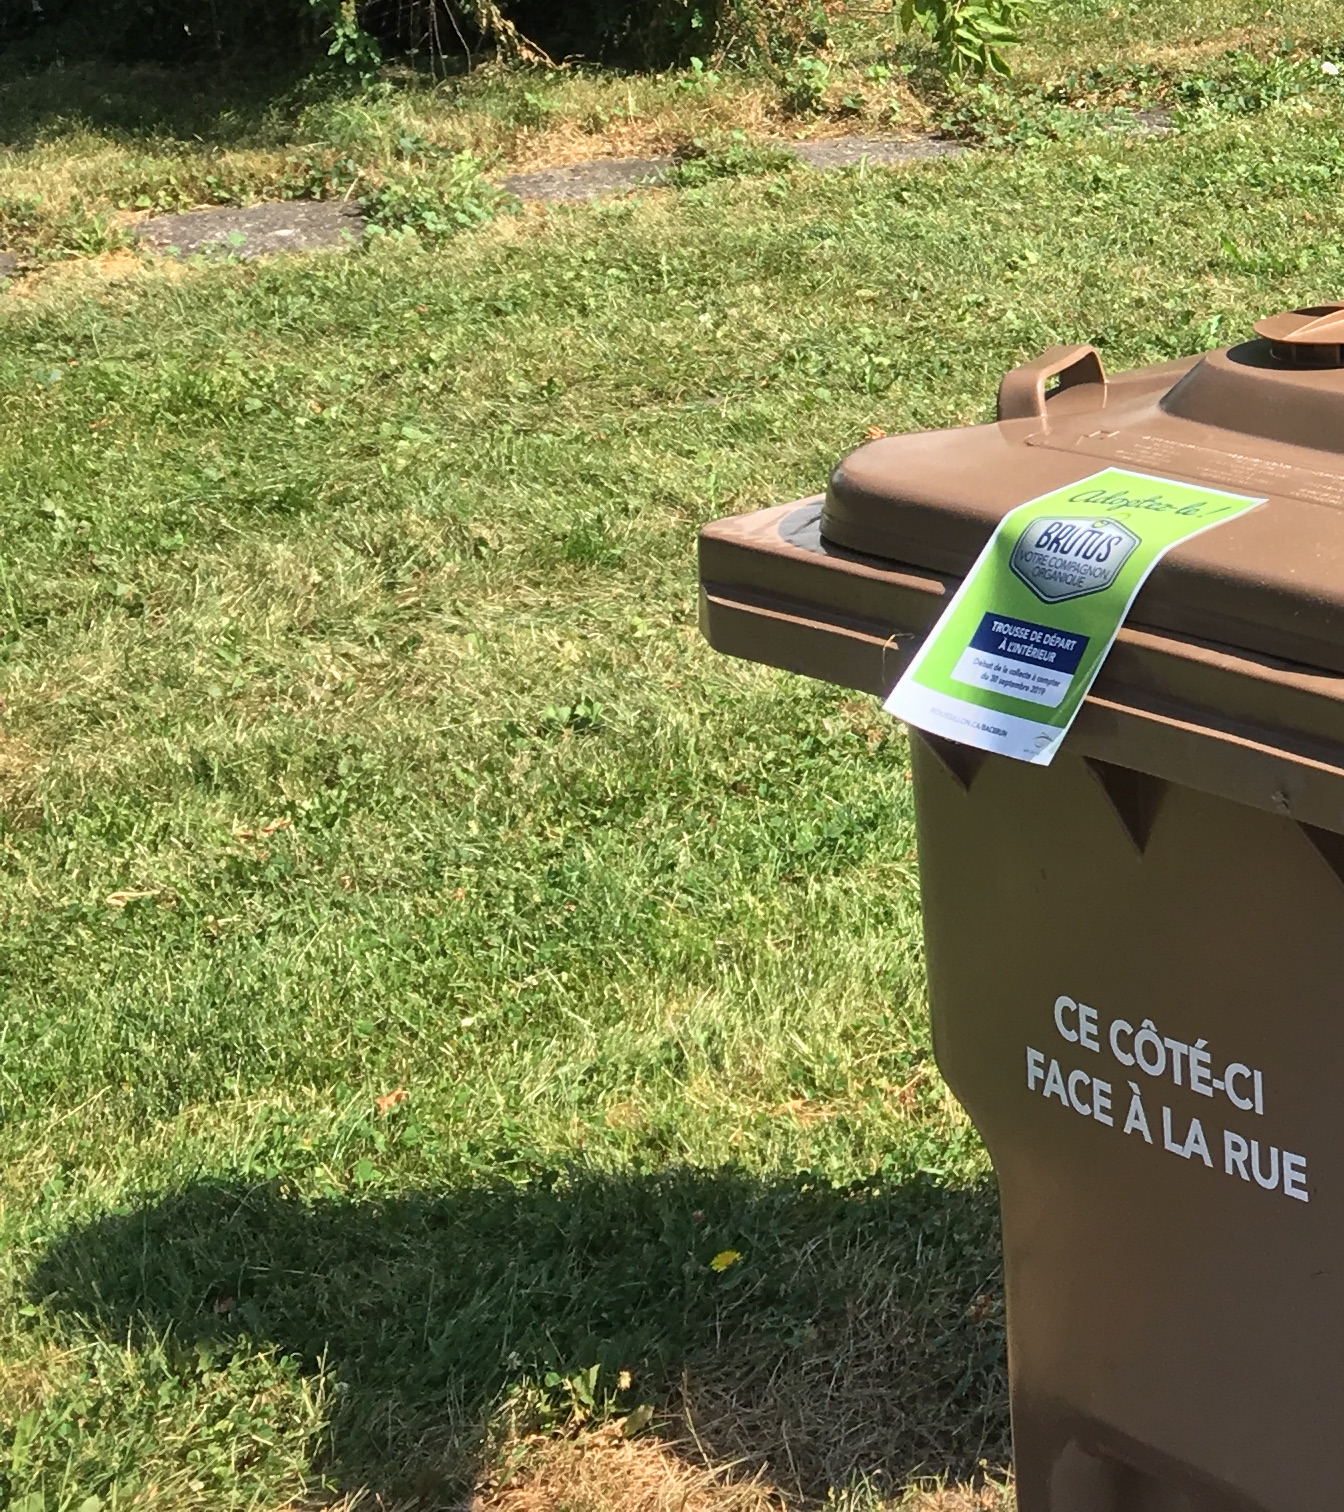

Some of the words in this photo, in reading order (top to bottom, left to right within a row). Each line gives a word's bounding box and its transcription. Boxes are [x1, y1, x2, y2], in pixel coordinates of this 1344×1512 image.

[1034, 521, 1122, 563] BRUTUS
[1019, 549, 1048, 566] VOTRE
[1048, 555, 1110, 580] COMPAGNON
[1031, 565, 1086, 588] ORGANIQUE
[991, 620, 1031, 639] TROUSSE
[1030, 630, 1043, 643] DE
[1043, 632, 1077, 651] DÉPART
[998, 637, 1007, 650] À
[1007, 641, 1057, 663] L'INTÉRIEUR
[994, 662, 1002, 672] de
[1009, 667, 1031, 680] collecte
[999, 677, 1030, 692] septembre
[1030, 684, 1046, 696] 2019
[1054, 995, 1100, 1053] CE
[1110, 1018, 1264, 1115] CÔTÉ-CI
[1026, 1046, 1114, 1127] FACE
[1123, 1081, 1153, 1144] À
[1162, 1106, 1214, 1168] LA
[1223, 1129, 1309, 1202] RUE
